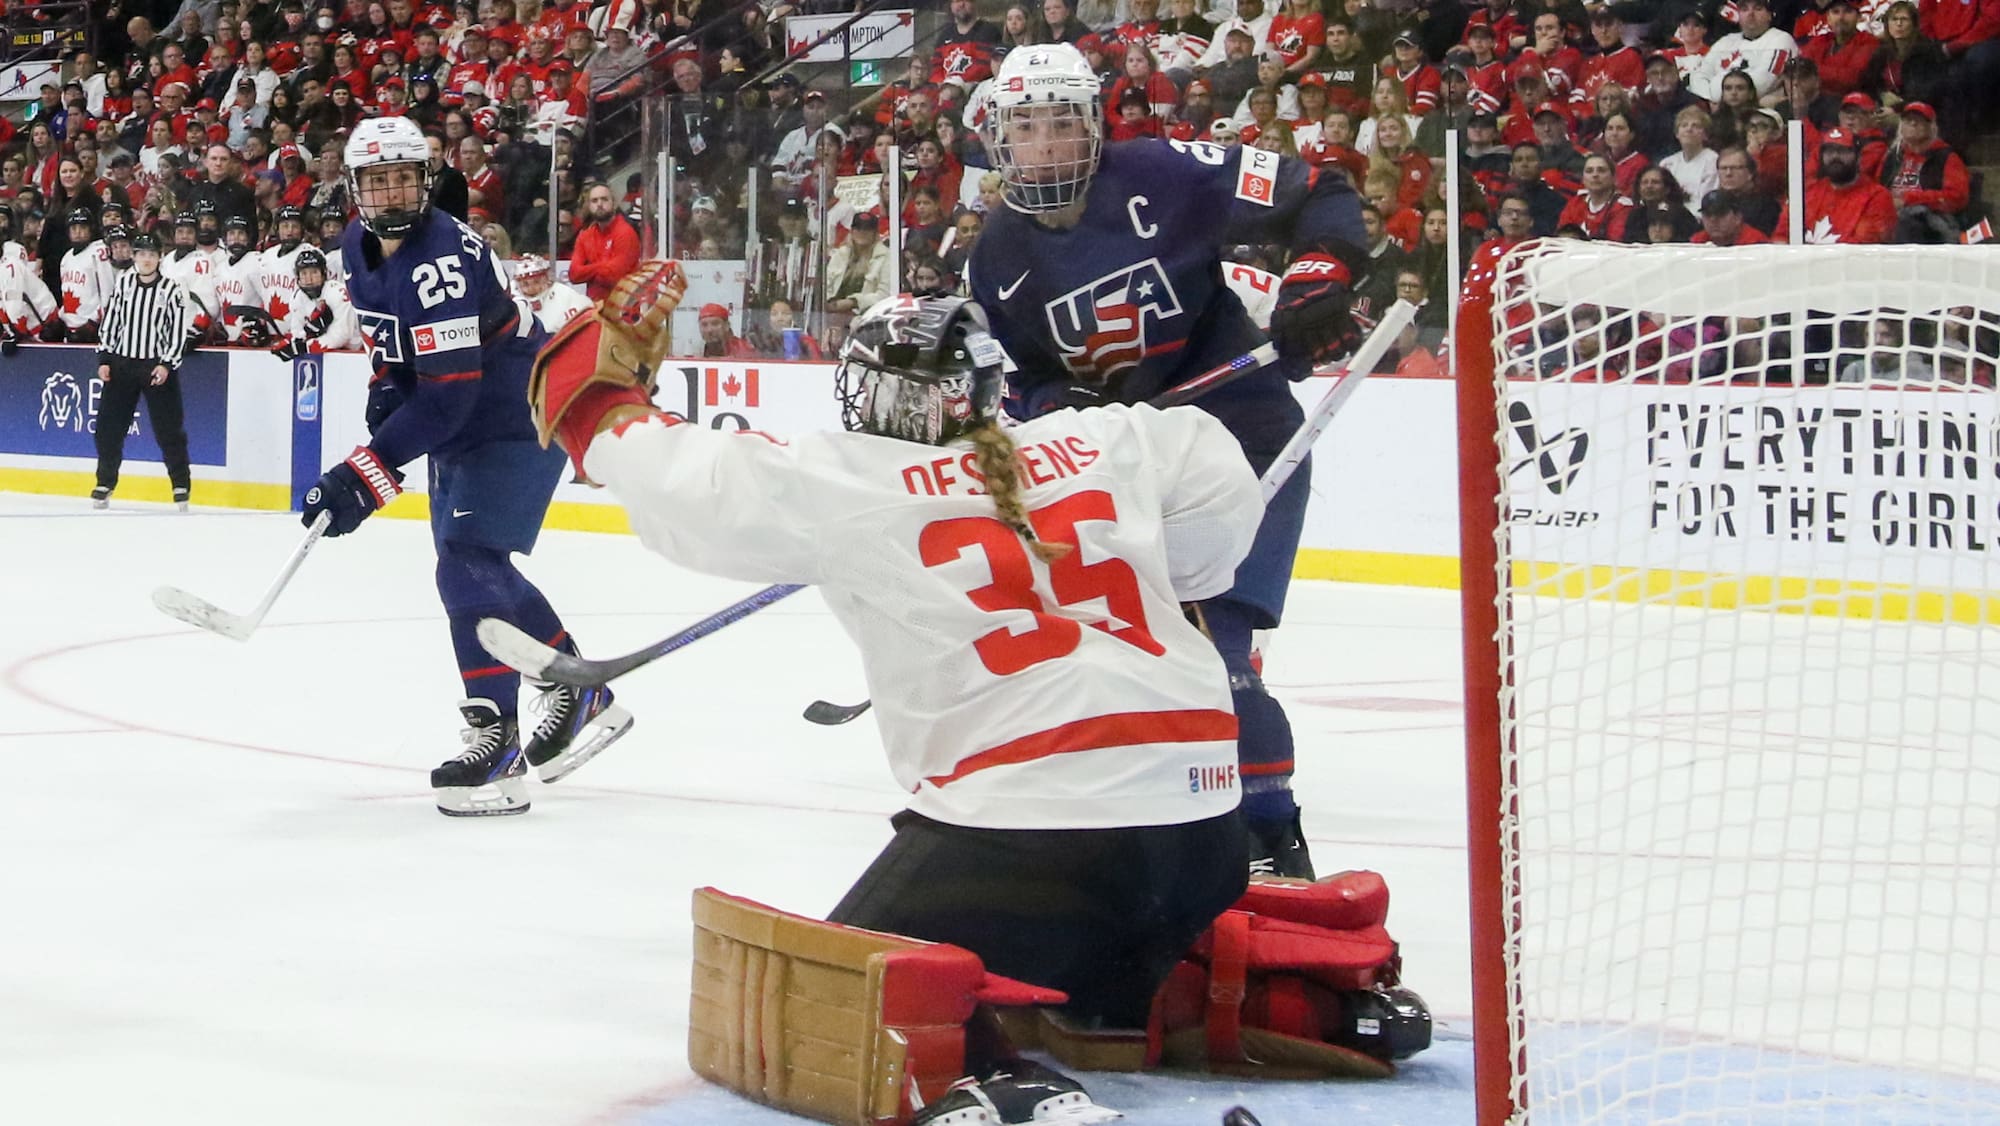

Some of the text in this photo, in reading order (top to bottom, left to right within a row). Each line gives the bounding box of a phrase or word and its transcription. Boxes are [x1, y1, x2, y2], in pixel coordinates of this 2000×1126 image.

[1028, 77, 1067, 86] TOYOTA
[382, 141, 412, 149] TOYOTA
[1127, 194, 1159, 240] C
[194, 260, 210, 275] 47
[411, 254, 467, 310] 25
[1045, 257, 1184, 386] USA
[902, 436, 1100, 496] DESENS
[1650, 481, 2000, 551] FOR THE GIRL
[918, 489, 1167, 676] 35
[1201, 765, 1235, 791] IIHF
